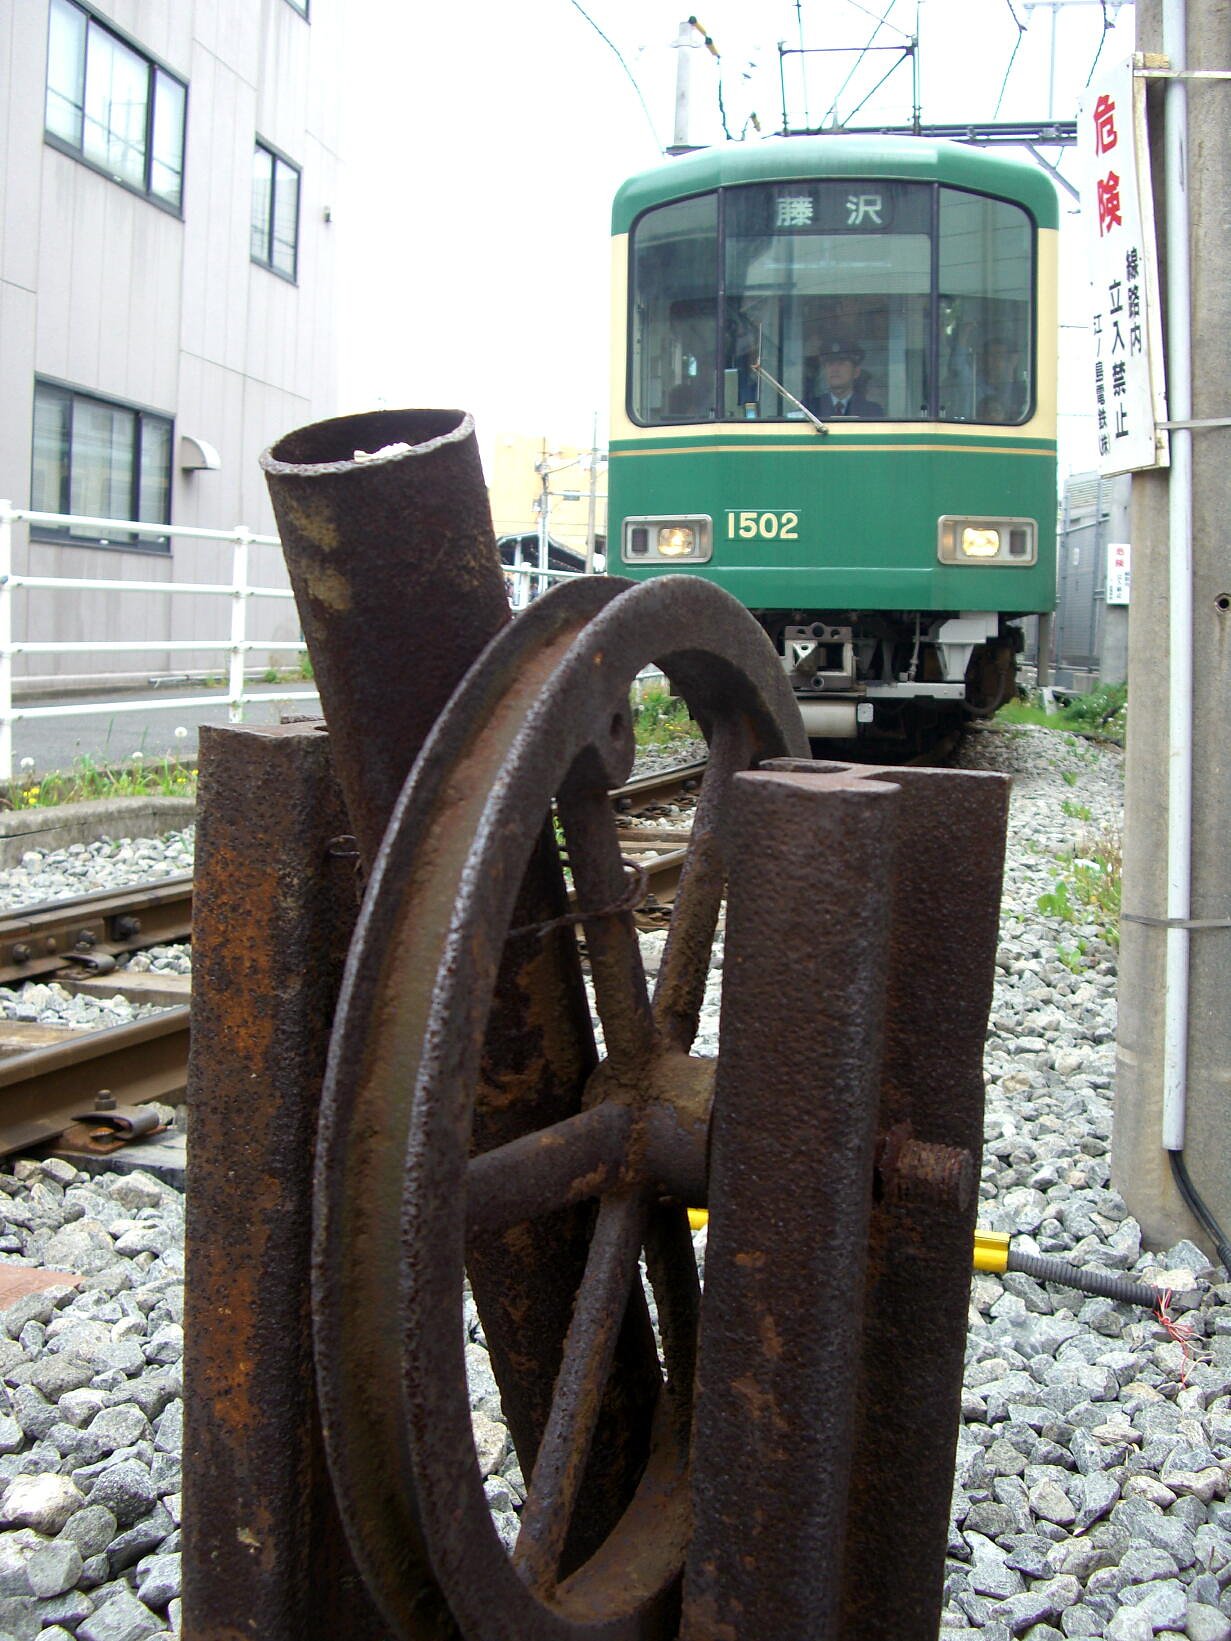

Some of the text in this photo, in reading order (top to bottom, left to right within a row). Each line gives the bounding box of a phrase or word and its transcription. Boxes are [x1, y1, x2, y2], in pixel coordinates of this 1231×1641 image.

[1093, 94, 1122, 238] 危険
[775, 194, 883, 227] 藤沢
[1108, 278, 1129, 439] 立入禁止
[727, 511, 799, 540] 1502
